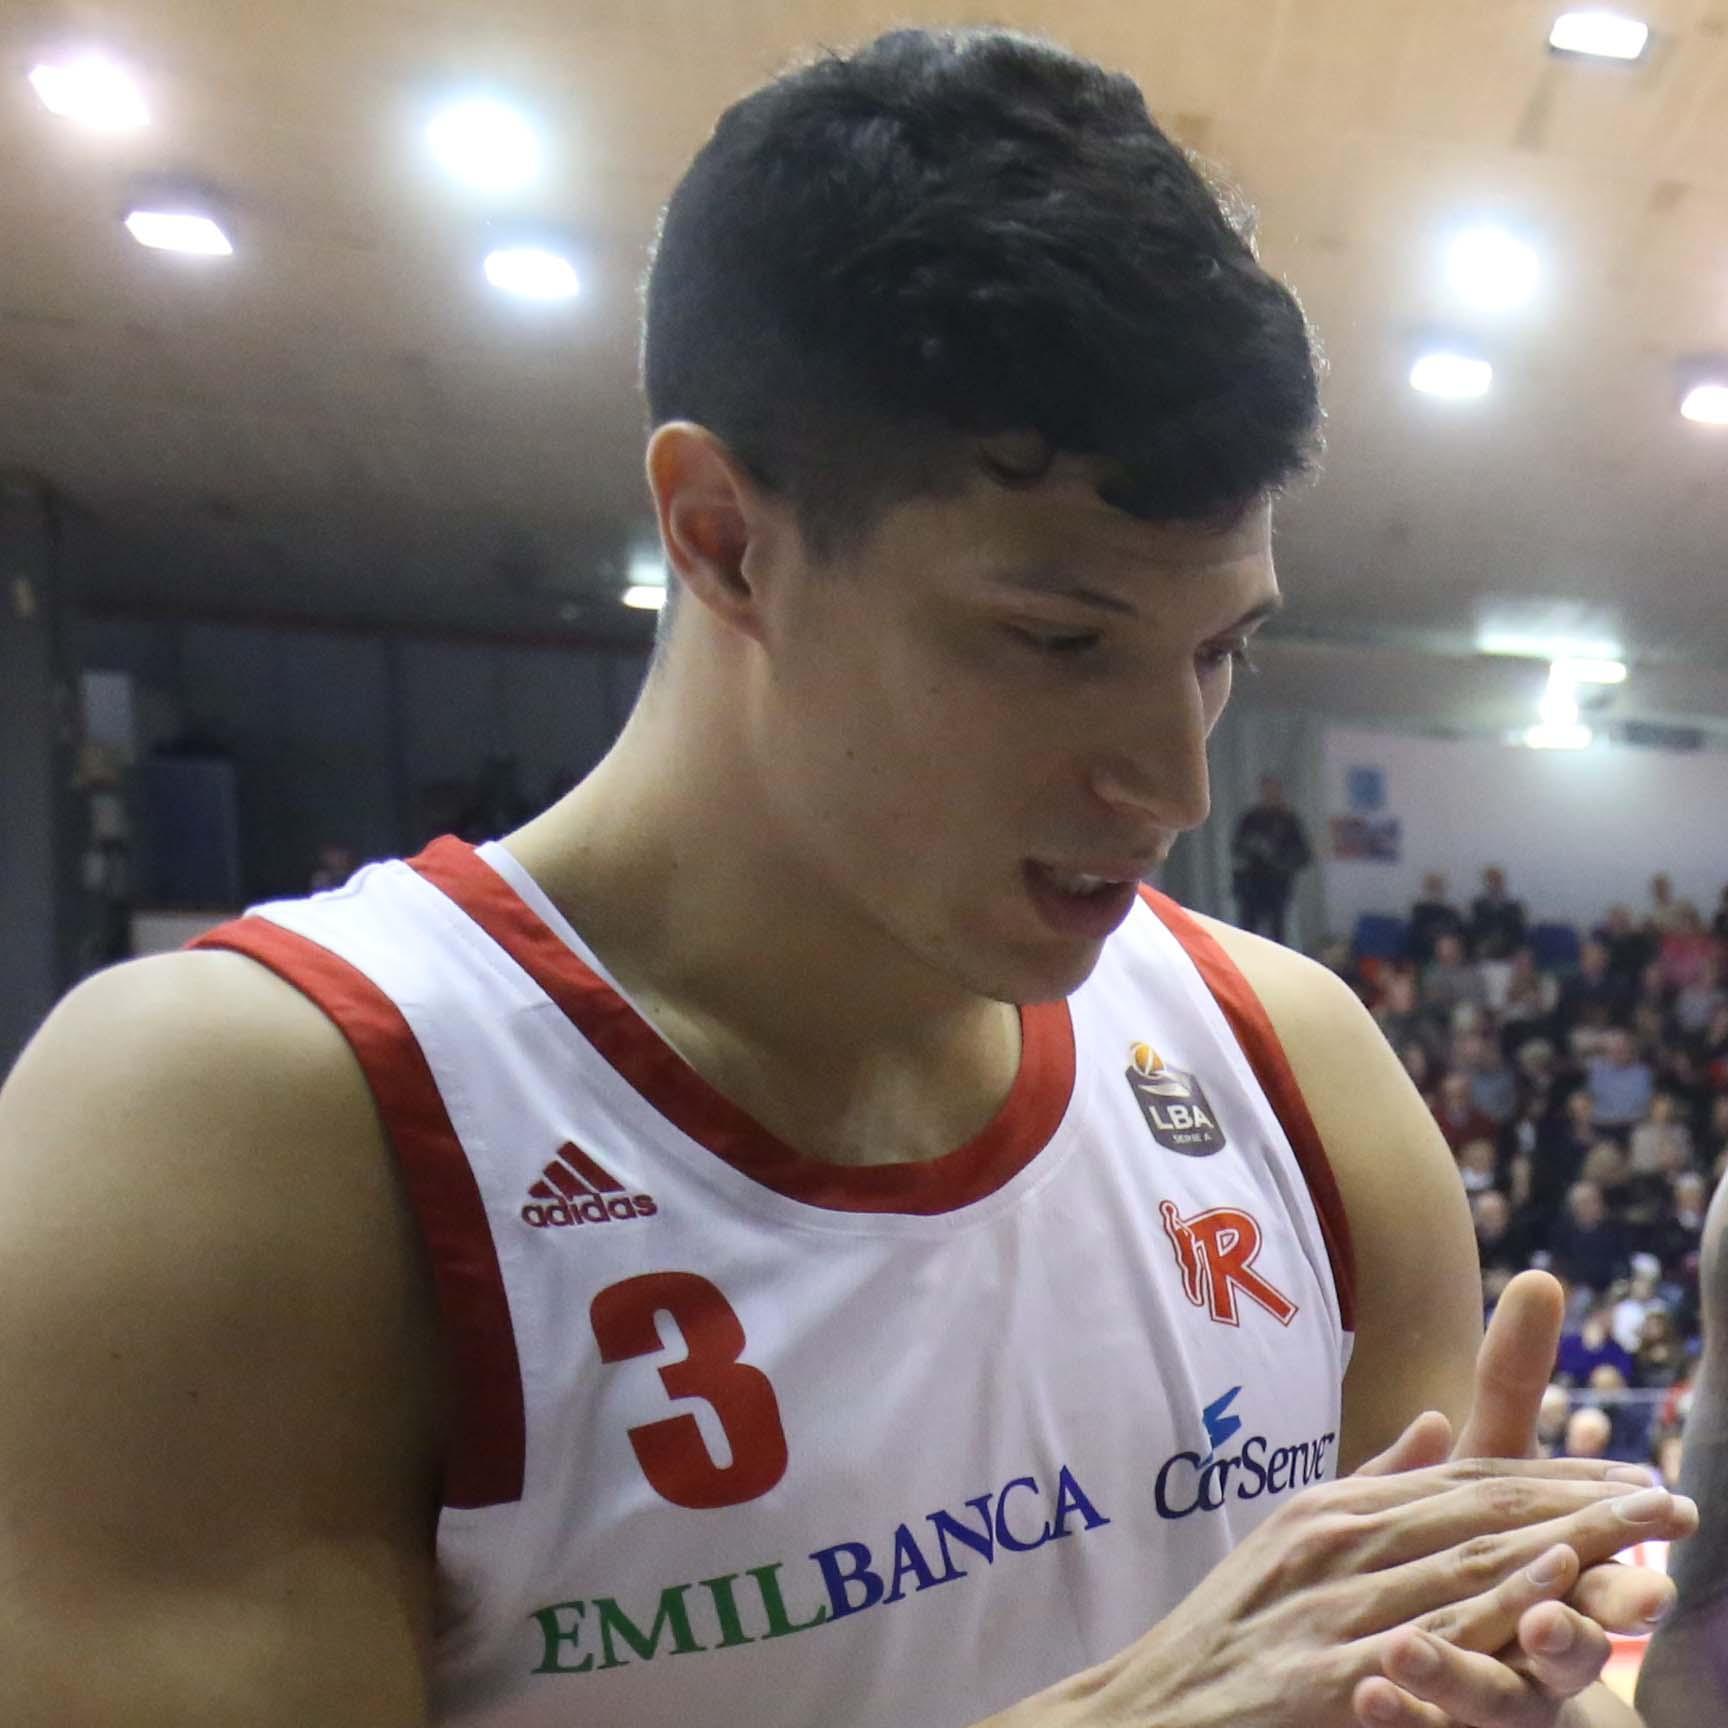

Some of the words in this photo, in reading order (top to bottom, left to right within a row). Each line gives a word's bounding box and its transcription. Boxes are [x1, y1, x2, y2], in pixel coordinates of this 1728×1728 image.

[1148, 1104, 1214, 1131] LBA
[519, 1188, 658, 1228] adidas
[589, 1270, 789, 1511] 3
[529, 1463, 1111, 1676] EMILBANCA
